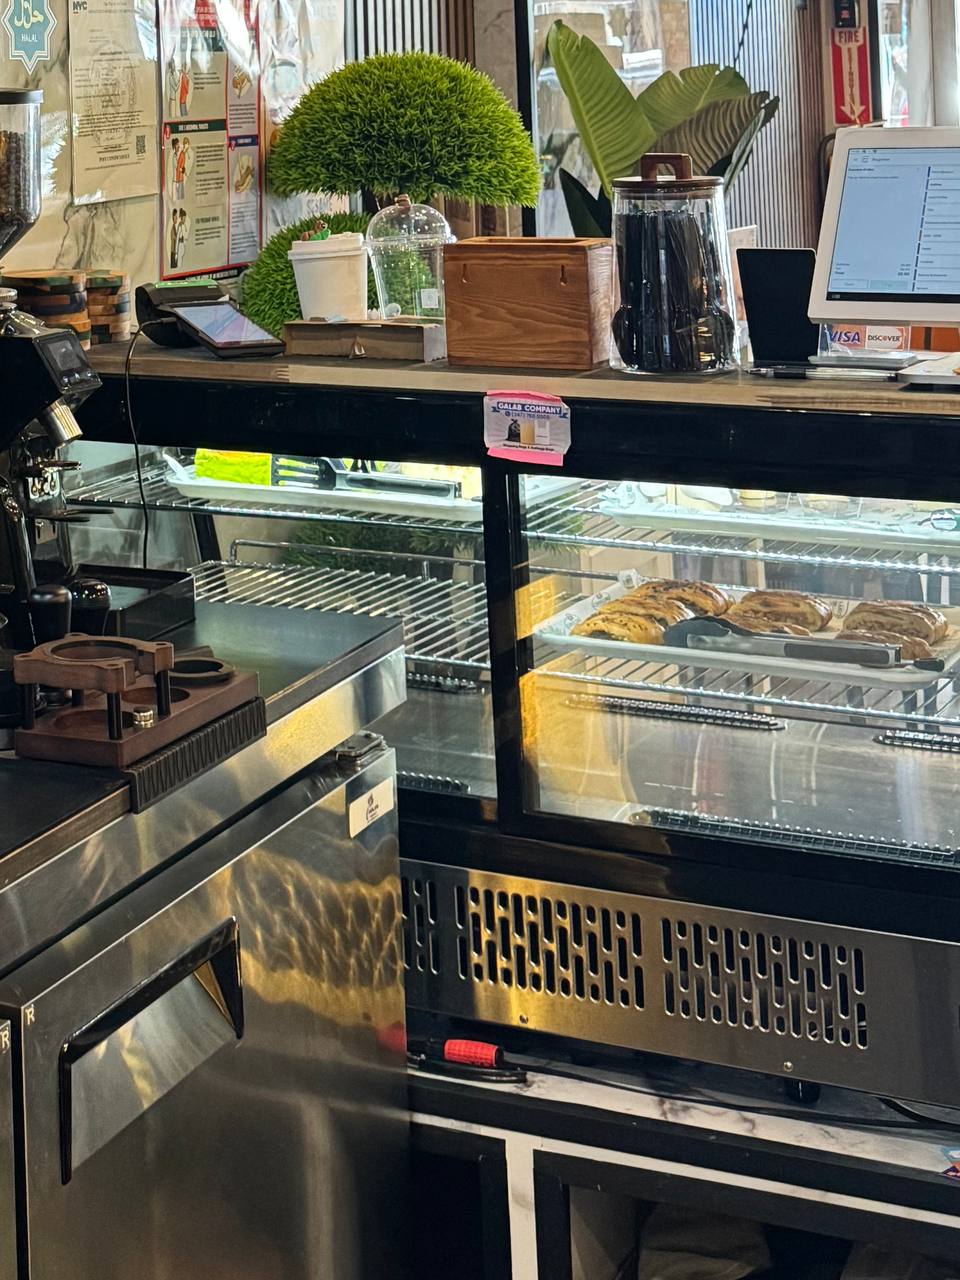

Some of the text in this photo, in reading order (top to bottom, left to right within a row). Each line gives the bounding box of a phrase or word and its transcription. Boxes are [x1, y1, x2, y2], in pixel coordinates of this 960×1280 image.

[20, 33, 38, 43] HALAL
[838, 30, 859, 44] FIRE
[830, 331, 901, 342] VISA DISCOVER
[498, 402, 561, 414] GALAB COMPANY
